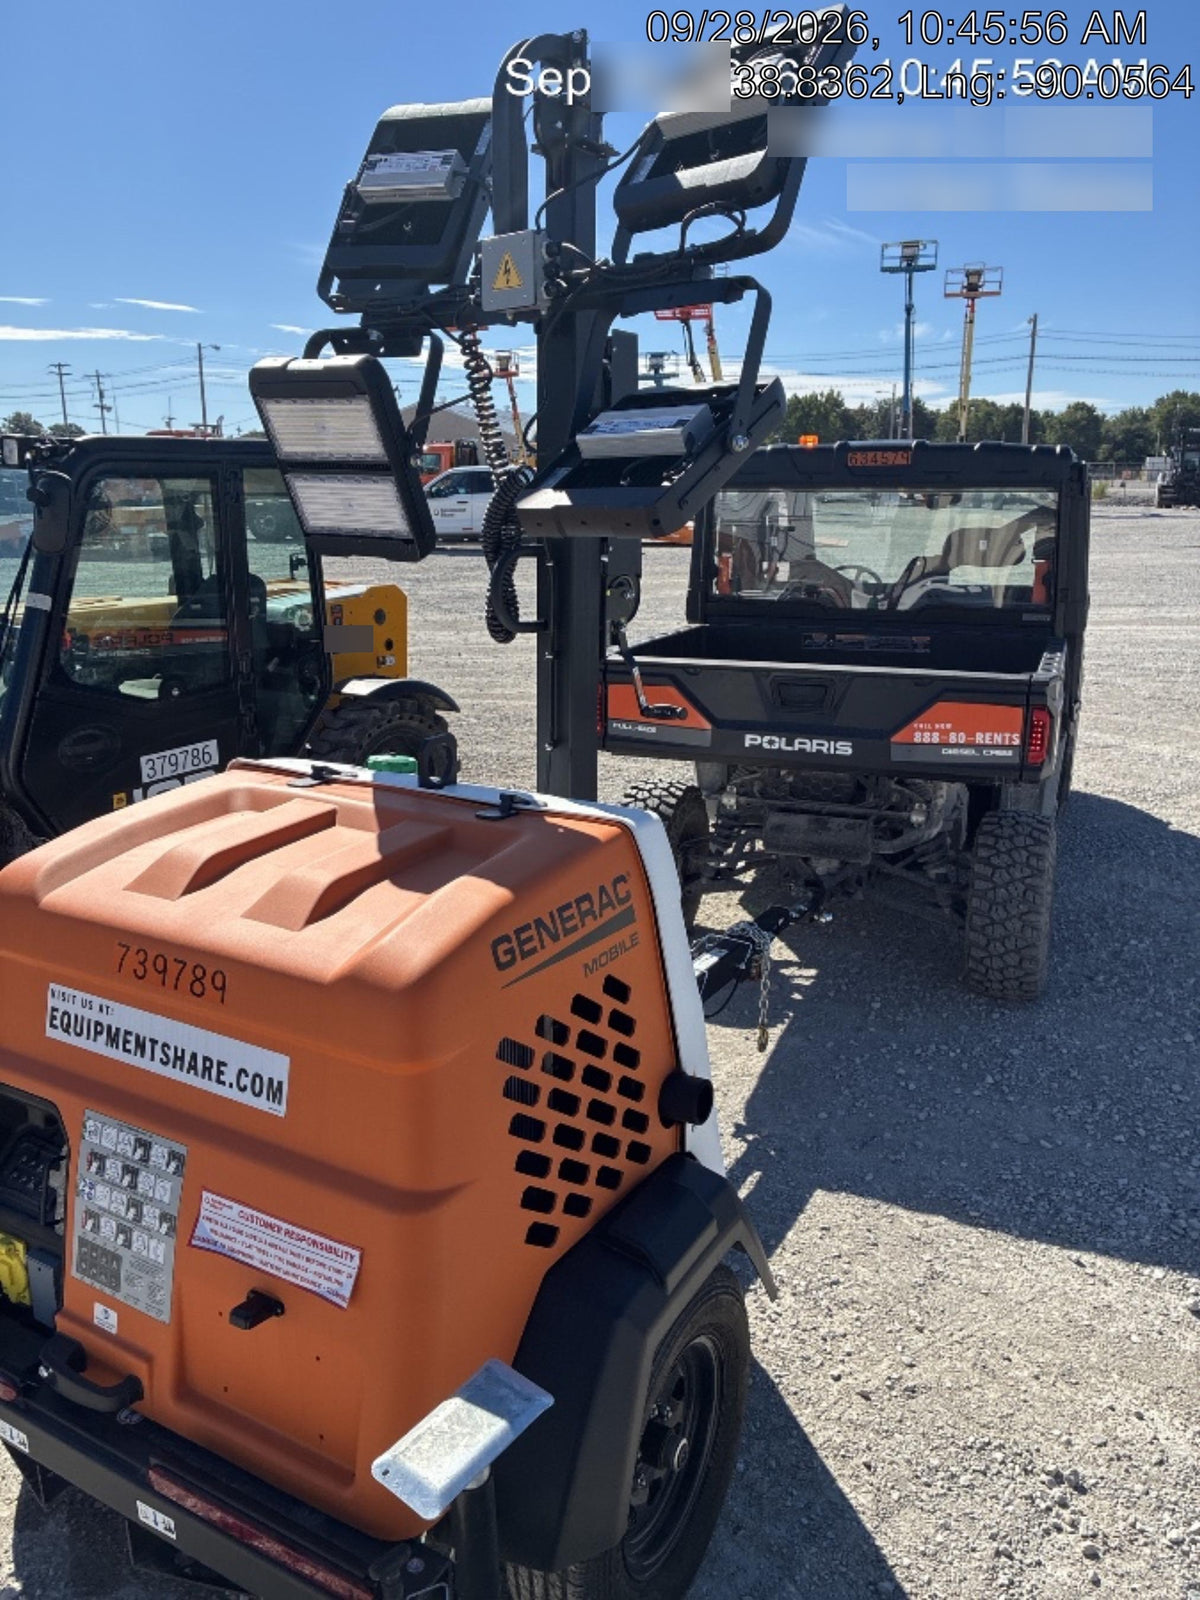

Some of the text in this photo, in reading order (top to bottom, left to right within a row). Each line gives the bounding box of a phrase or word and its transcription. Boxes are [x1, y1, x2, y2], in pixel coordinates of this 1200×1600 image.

[145, 744, 212, 779] 379786
[744, 733, 853, 756] POLARIS
[490, 874, 632, 971] GENERAC
[117, 942, 227, 1004] 739789
[582, 931, 640, 978] MOBILE
[80, 998, 94, 1011] US
[48, 1005, 284, 1107] EQUIPMENTSHARE.COM
